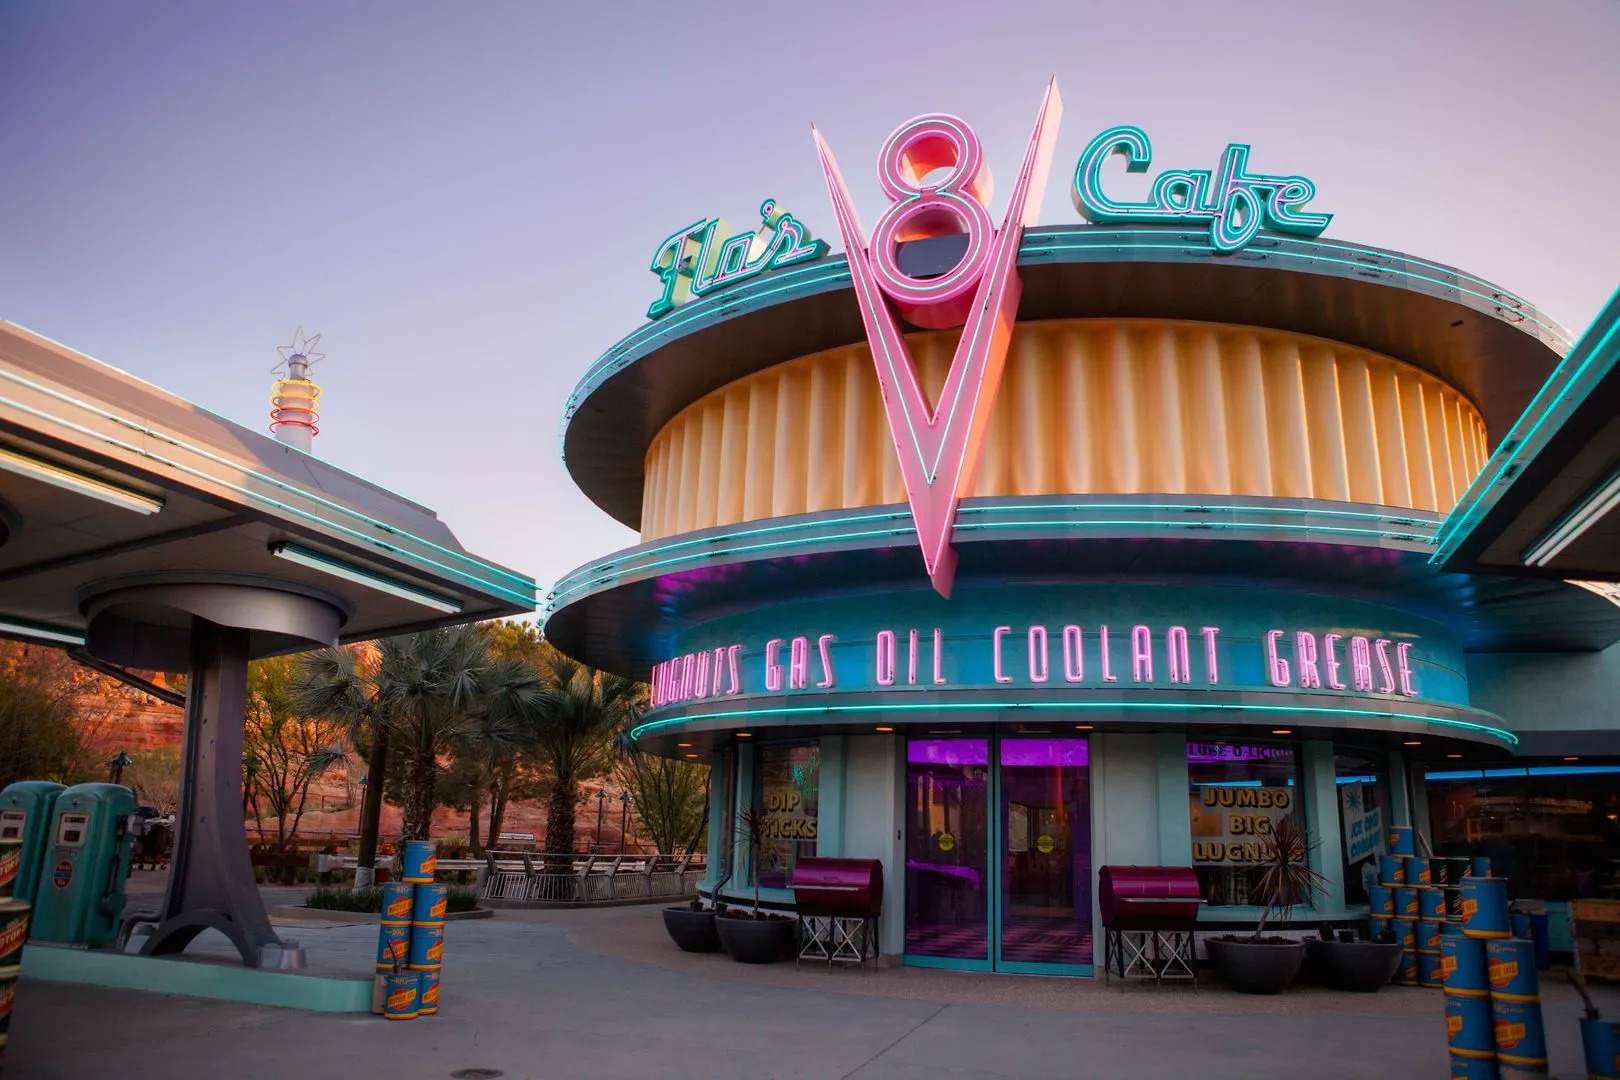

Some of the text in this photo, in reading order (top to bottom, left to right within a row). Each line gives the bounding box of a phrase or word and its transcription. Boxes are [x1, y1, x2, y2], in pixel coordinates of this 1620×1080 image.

[646, 197, 832, 319] Flo's
[1071, 125, 1334, 254] Cafe
[650, 625, 1418, 708] LUGNUTS GAS OIL COOLANT GREASE
[769, 790, 800, 812] DIP
[1204, 787, 1291, 809] JUMBO
[761, 818, 818, 840] TICKS
[1229, 814, 1272, 836] BIG
[1193, 842, 1304, 863] LUGNU
